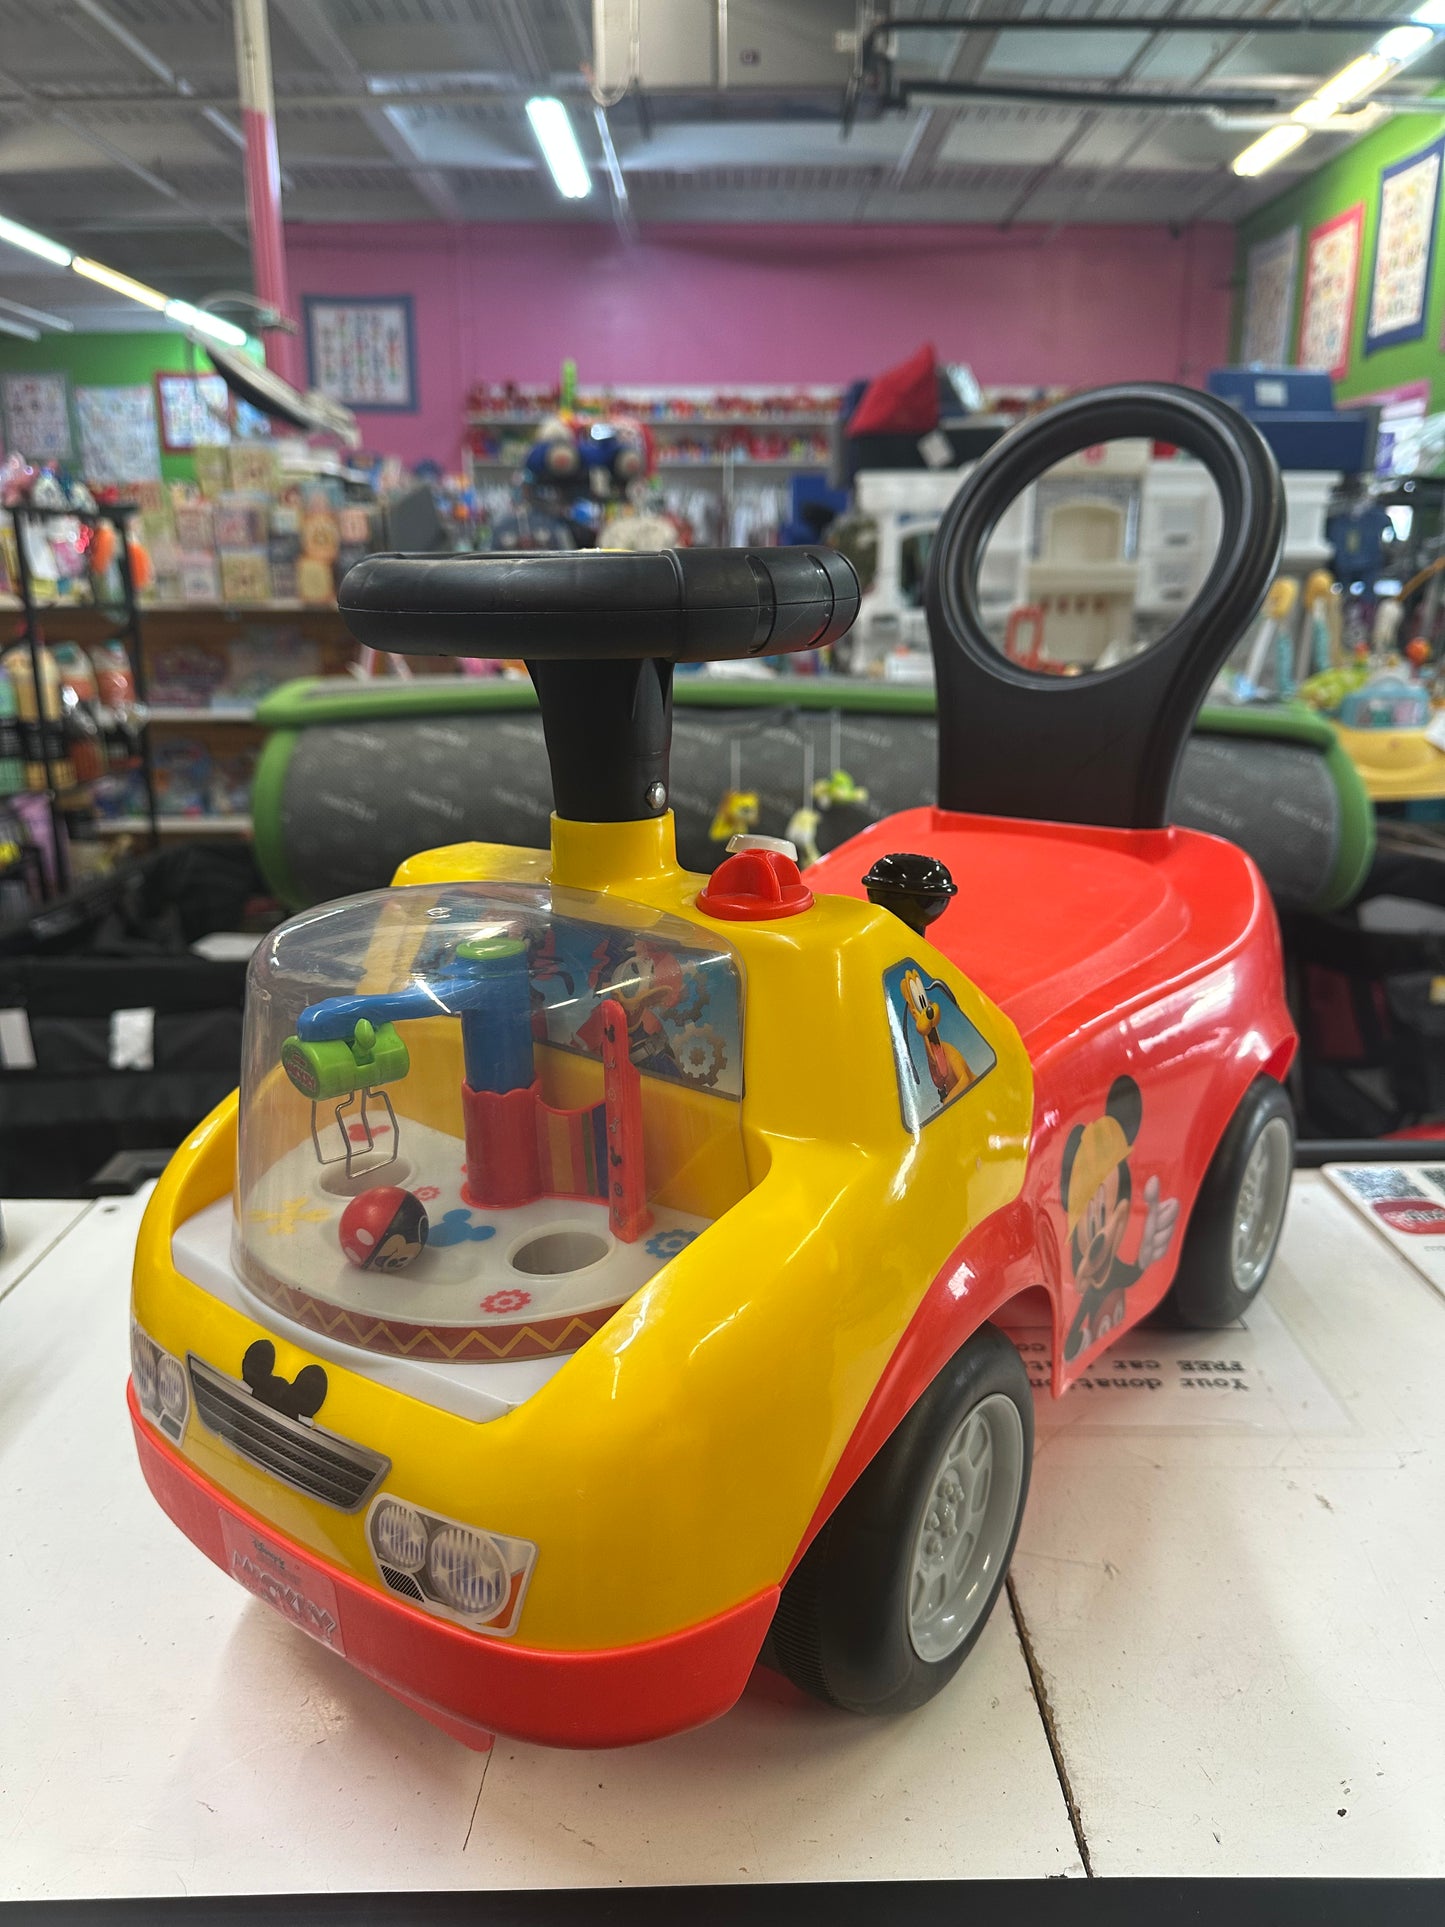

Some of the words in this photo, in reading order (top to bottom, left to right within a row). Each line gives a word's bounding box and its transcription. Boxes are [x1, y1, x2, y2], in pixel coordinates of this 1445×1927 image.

[1112, 1359, 1161, 1370] car
[1176, 1359, 1246, 1372] FREE
[1180, 1377, 1249, 1392] Your
